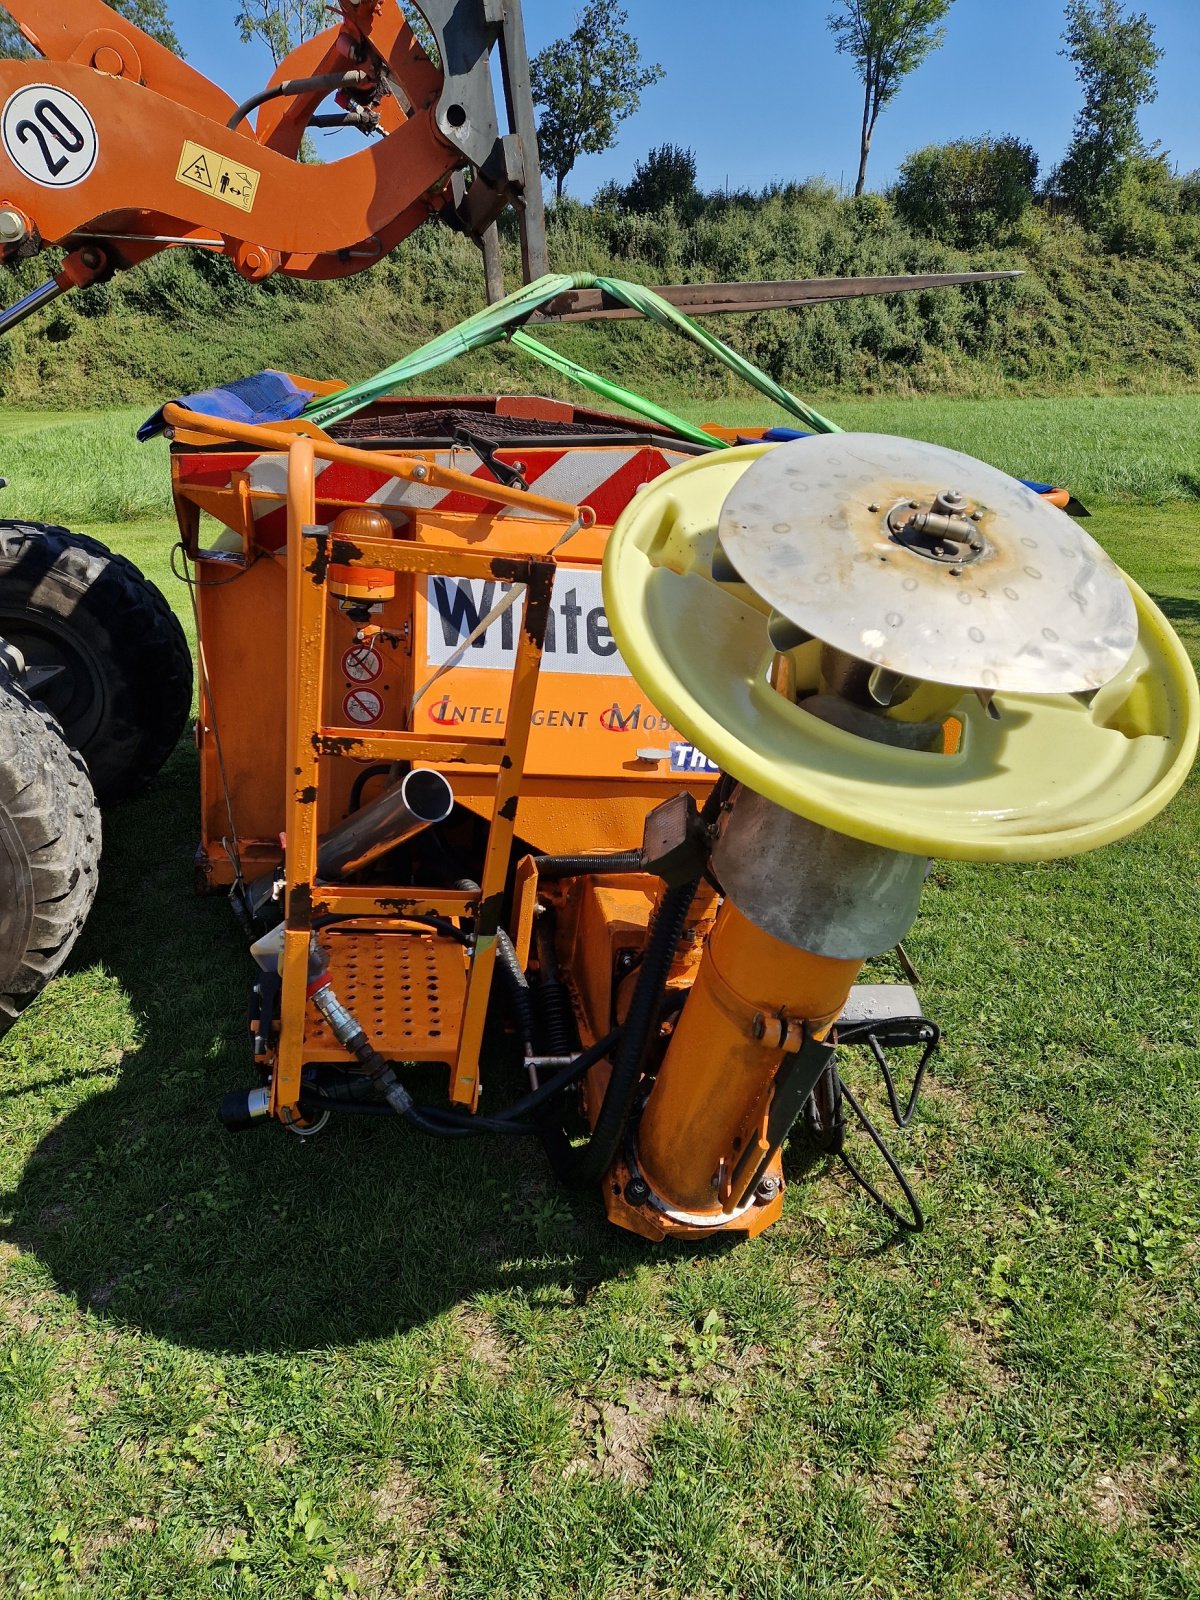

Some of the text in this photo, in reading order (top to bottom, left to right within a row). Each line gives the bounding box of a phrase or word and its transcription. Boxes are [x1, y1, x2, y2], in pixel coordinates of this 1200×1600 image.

[16, 99, 85, 177] 20
[432, 576, 619, 657] Wite
[437, 694, 675, 731] INTELGENT MOB
